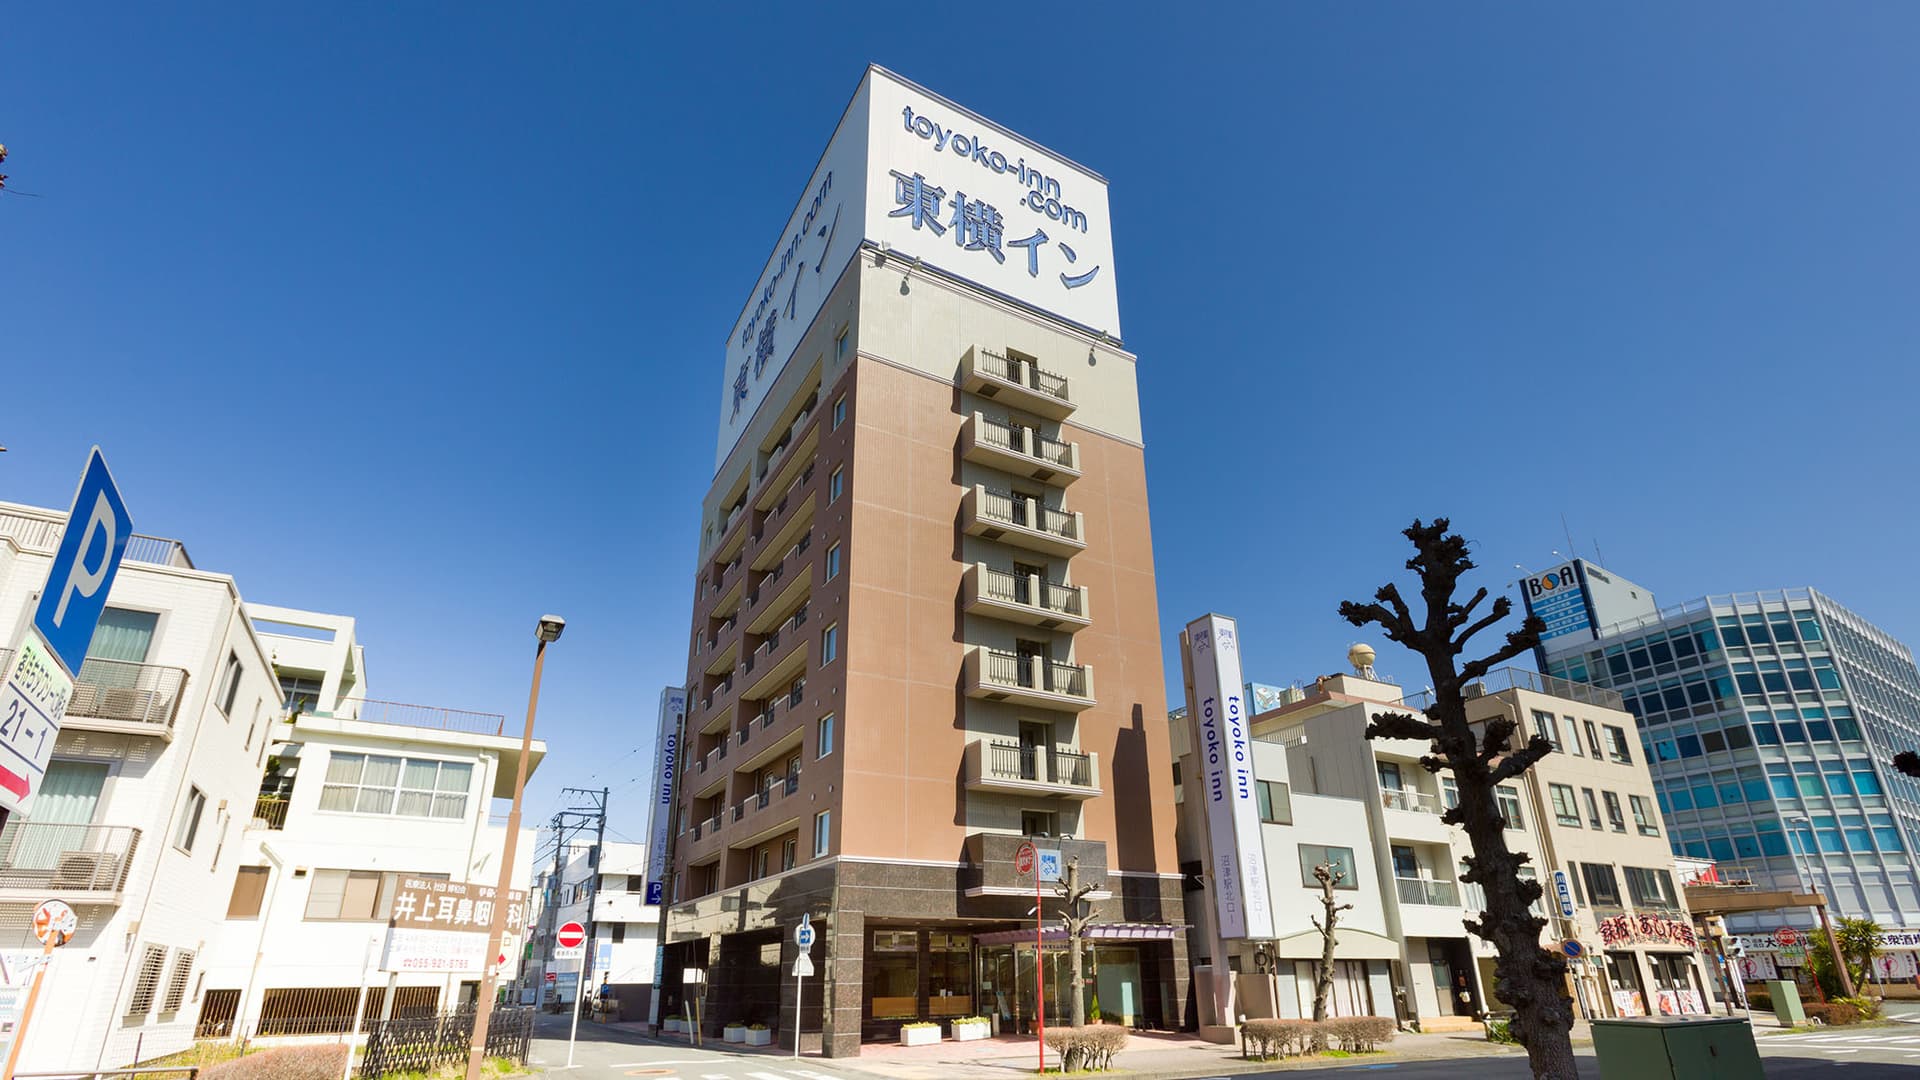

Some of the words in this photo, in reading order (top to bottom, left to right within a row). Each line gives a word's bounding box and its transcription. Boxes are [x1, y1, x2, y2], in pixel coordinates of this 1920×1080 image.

[902, 105, 1061, 199] toyoko-inn
[887, 168, 1100, 290] 東横イン
[1019, 190, 1088, 234] .com
[742, 171, 833, 349] toyoko-inn.com
[53, 488, 116, 628] P
[0, 698, 48, 760] 21-1
[1203, 696, 1220, 765] toyoko
[1229, 695, 1246, 762] toyoko
[664, 734, 677, 780] toyoko
[1236, 768, 1249, 800] inn
[661, 783, 673, 805] inn
[1211, 769, 1223, 802] inn
[393, 891, 523, 929] 井上耳鼻咽科
[652, 883, 662, 894] P
